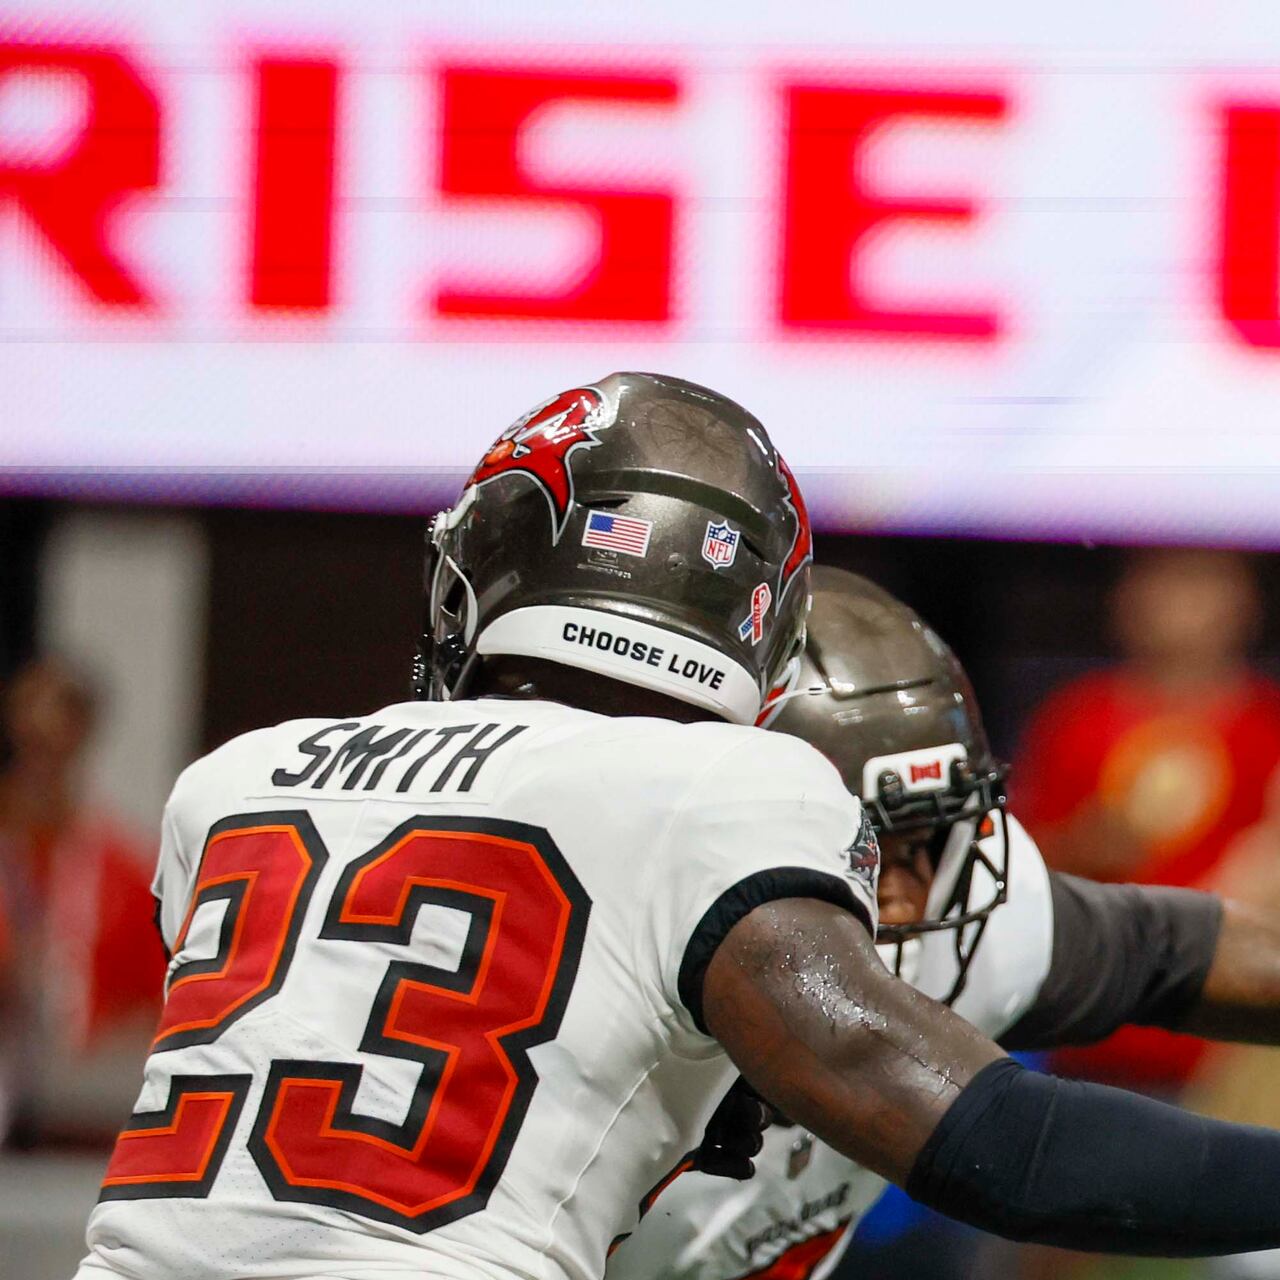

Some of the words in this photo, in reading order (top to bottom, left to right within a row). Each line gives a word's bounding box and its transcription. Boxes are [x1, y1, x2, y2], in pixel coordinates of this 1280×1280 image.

[0, 40, 1012, 340] RISE
[706, 539, 731, 563] NFL
[562, 622, 664, 667] CHOOSE
[667, 654, 725, 690] LOVE
[271, 721, 529, 793] SMITH
[98, 809, 593, 1235] 23
